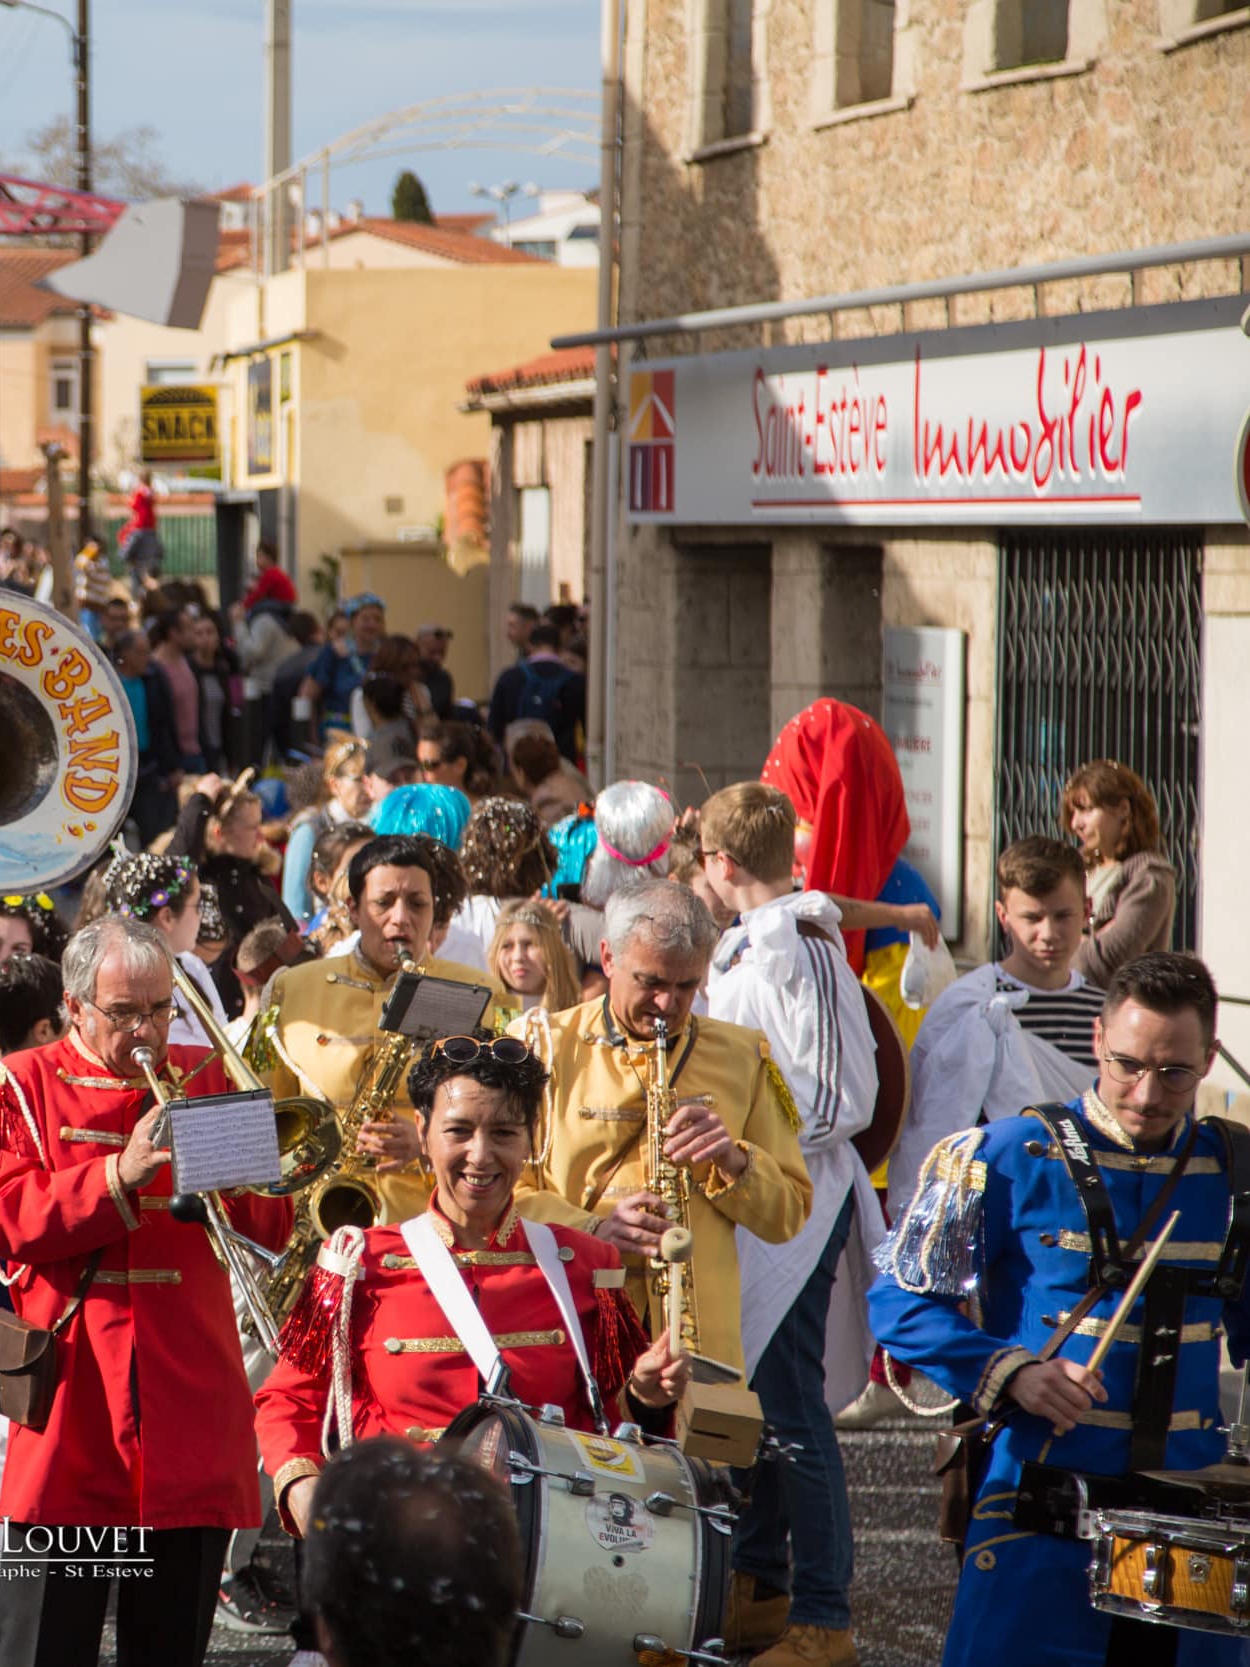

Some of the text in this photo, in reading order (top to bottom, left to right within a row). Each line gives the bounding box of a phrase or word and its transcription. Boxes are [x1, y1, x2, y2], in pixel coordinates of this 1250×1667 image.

[753, 343, 1142, 488] Saint-Estève Immobilier
[43, 648, 120, 814] BAND
